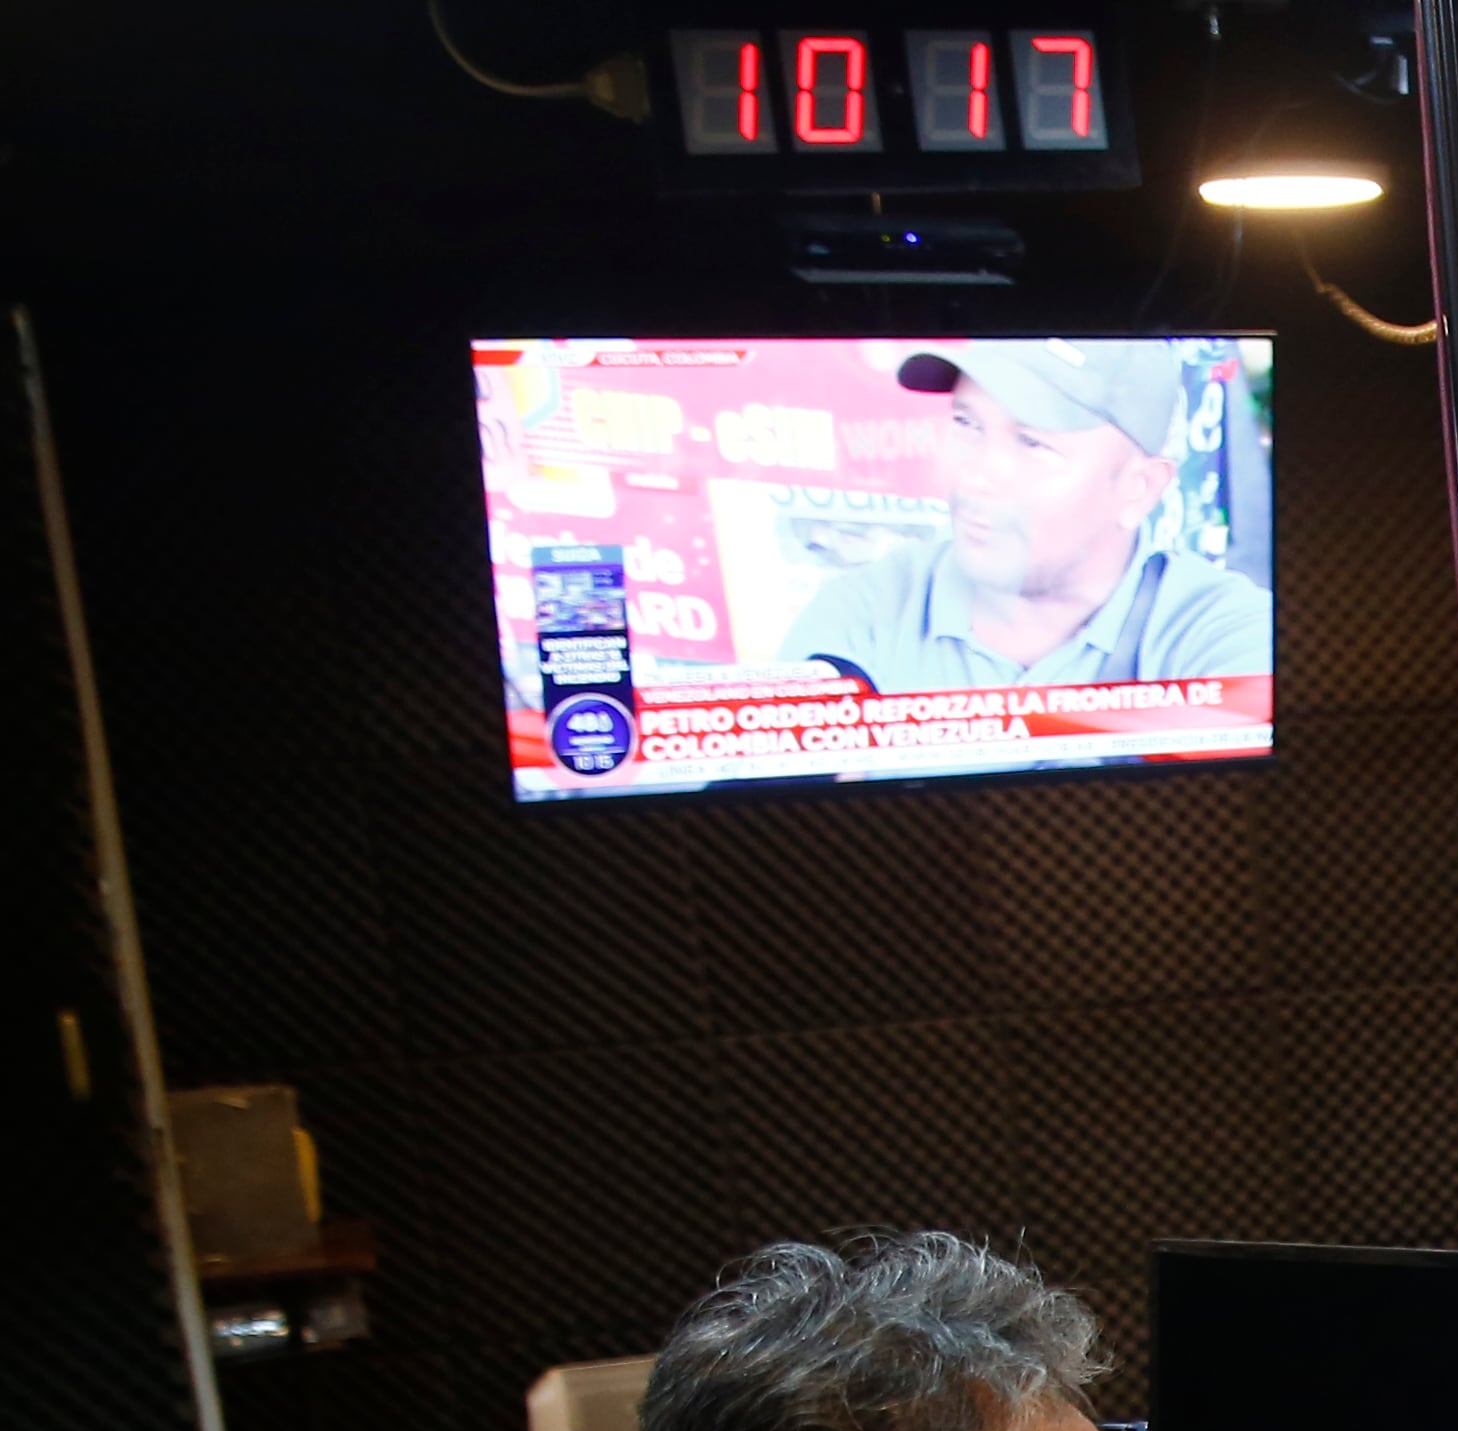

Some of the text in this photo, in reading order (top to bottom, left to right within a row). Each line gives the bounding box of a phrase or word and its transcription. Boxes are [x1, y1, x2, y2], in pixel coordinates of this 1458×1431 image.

[738, 36, 1093, 144] 10 17
[640, 681, 1223, 735] PETRO ORDENÓ REFORZAR LA FRONTERA DE
[641, 716, 1031, 761] COLOMBIA CON VENEZUELA
